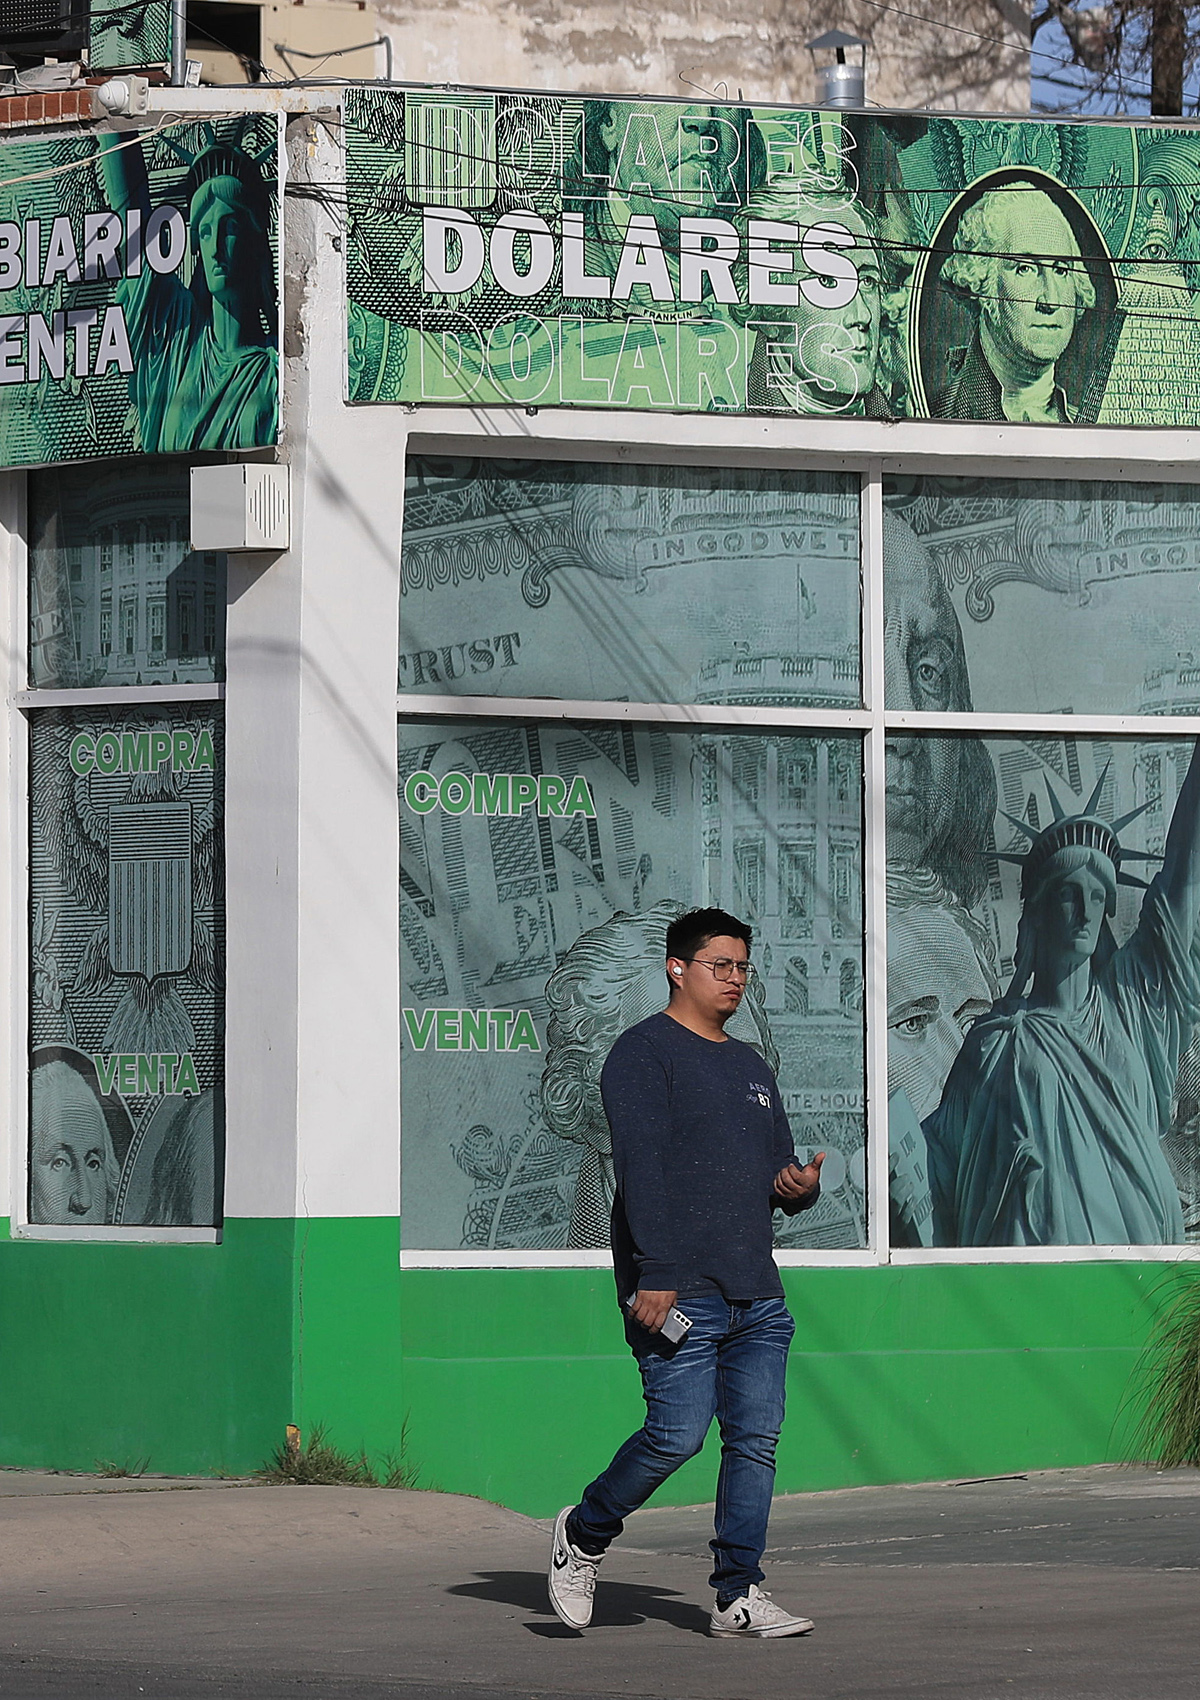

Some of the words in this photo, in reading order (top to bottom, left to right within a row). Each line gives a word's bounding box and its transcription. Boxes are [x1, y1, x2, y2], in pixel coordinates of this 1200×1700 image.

[421, 104, 859, 212] DOLARES
[422, 206, 860, 309] DOLARES
[643, 309, 693, 321] FRANKLIN
[420, 309, 860, 413] DOLARES
[652, 538, 685, 560] IN
[697, 531, 769, 554] GOD
[780, 530, 827, 550] WE
[1095, 551, 1129, 574] IN
[69, 729, 217, 777] COMPRA
[404, 770, 597, 818] COMPRA
[402, 1008, 541, 1053] VENTA
[92, 1052, 201, 1097] VENTA
[757, 1092, 771, 1109] 87
